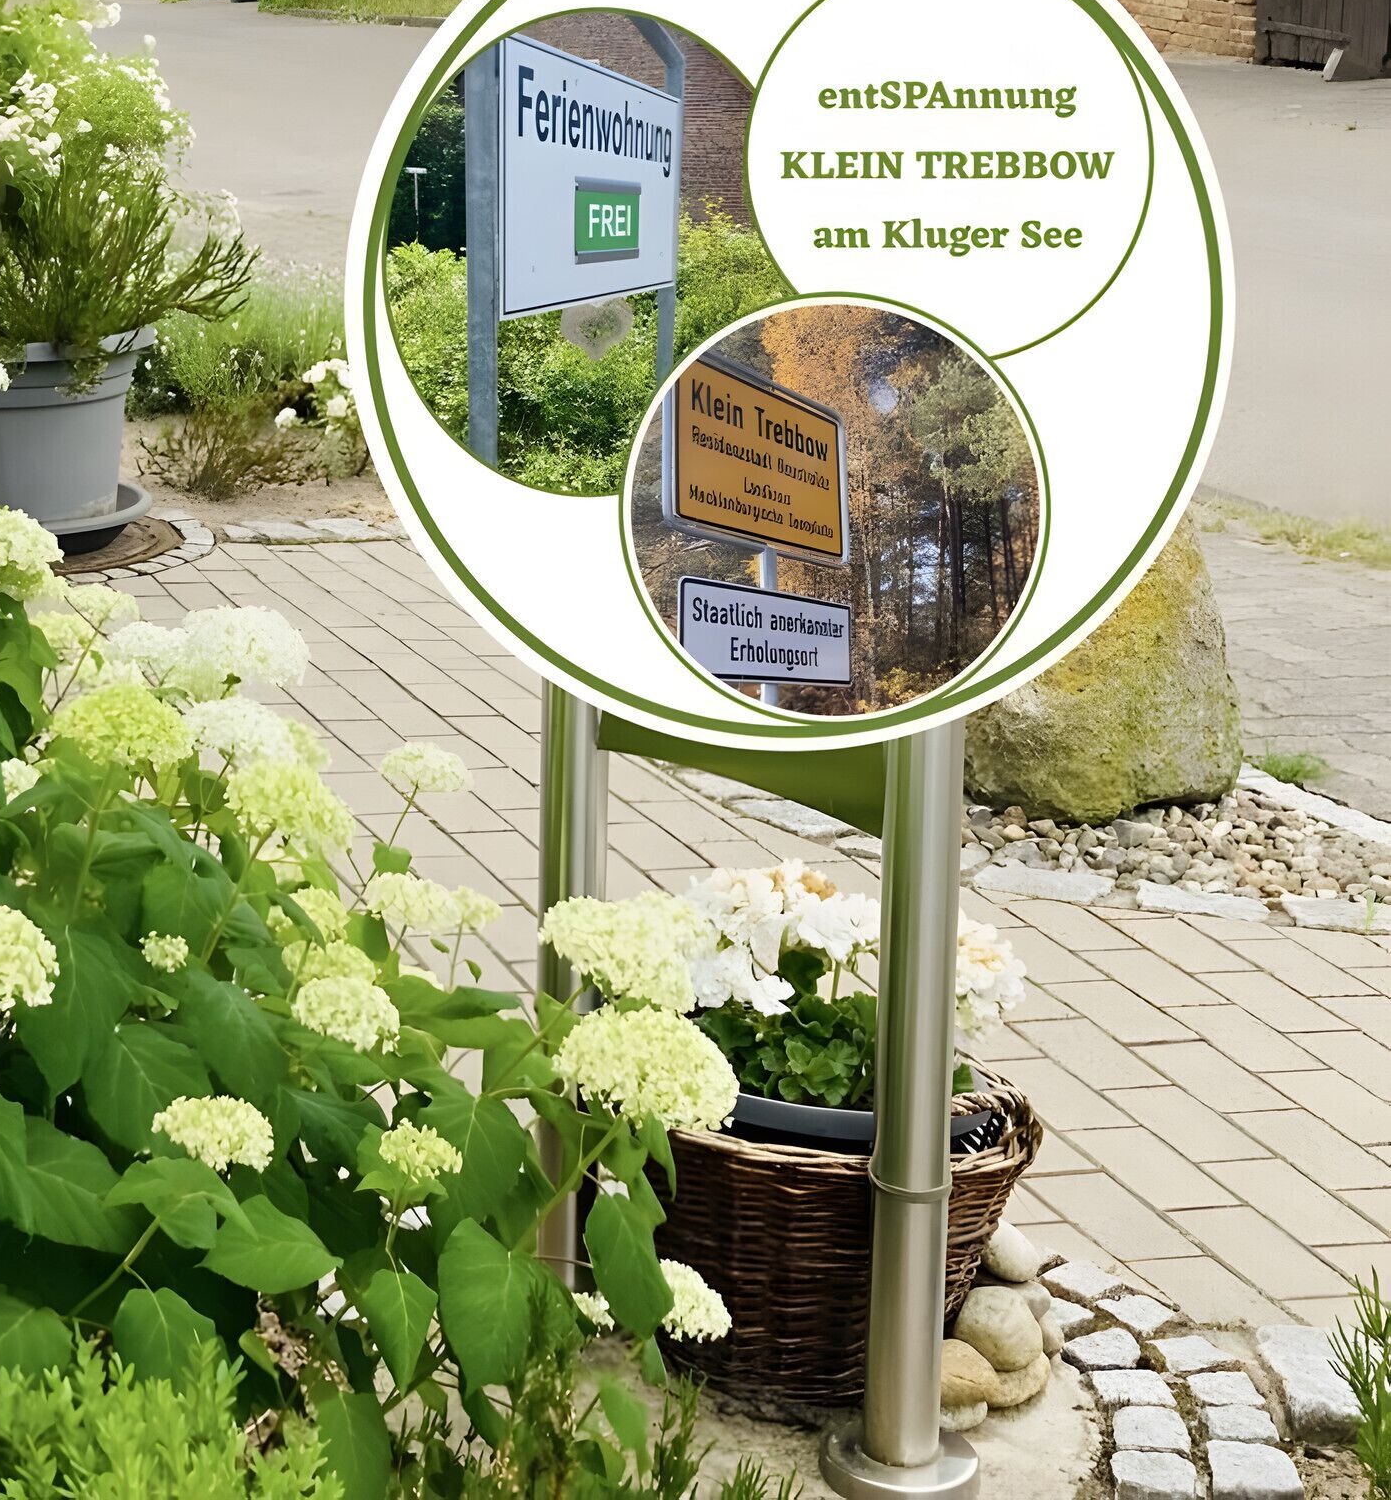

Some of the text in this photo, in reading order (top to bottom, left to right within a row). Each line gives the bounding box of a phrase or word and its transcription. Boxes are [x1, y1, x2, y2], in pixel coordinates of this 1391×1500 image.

[518, 65, 672, 178] Ferienwohnung
[588, 203, 632, 239] FREI
[691, 378, 744, 430] Klein
[754, 405, 828, 462] Trebbow
[692, 596, 763, 629] Staatlich
[730, 636, 819, 672] Erholungsort
